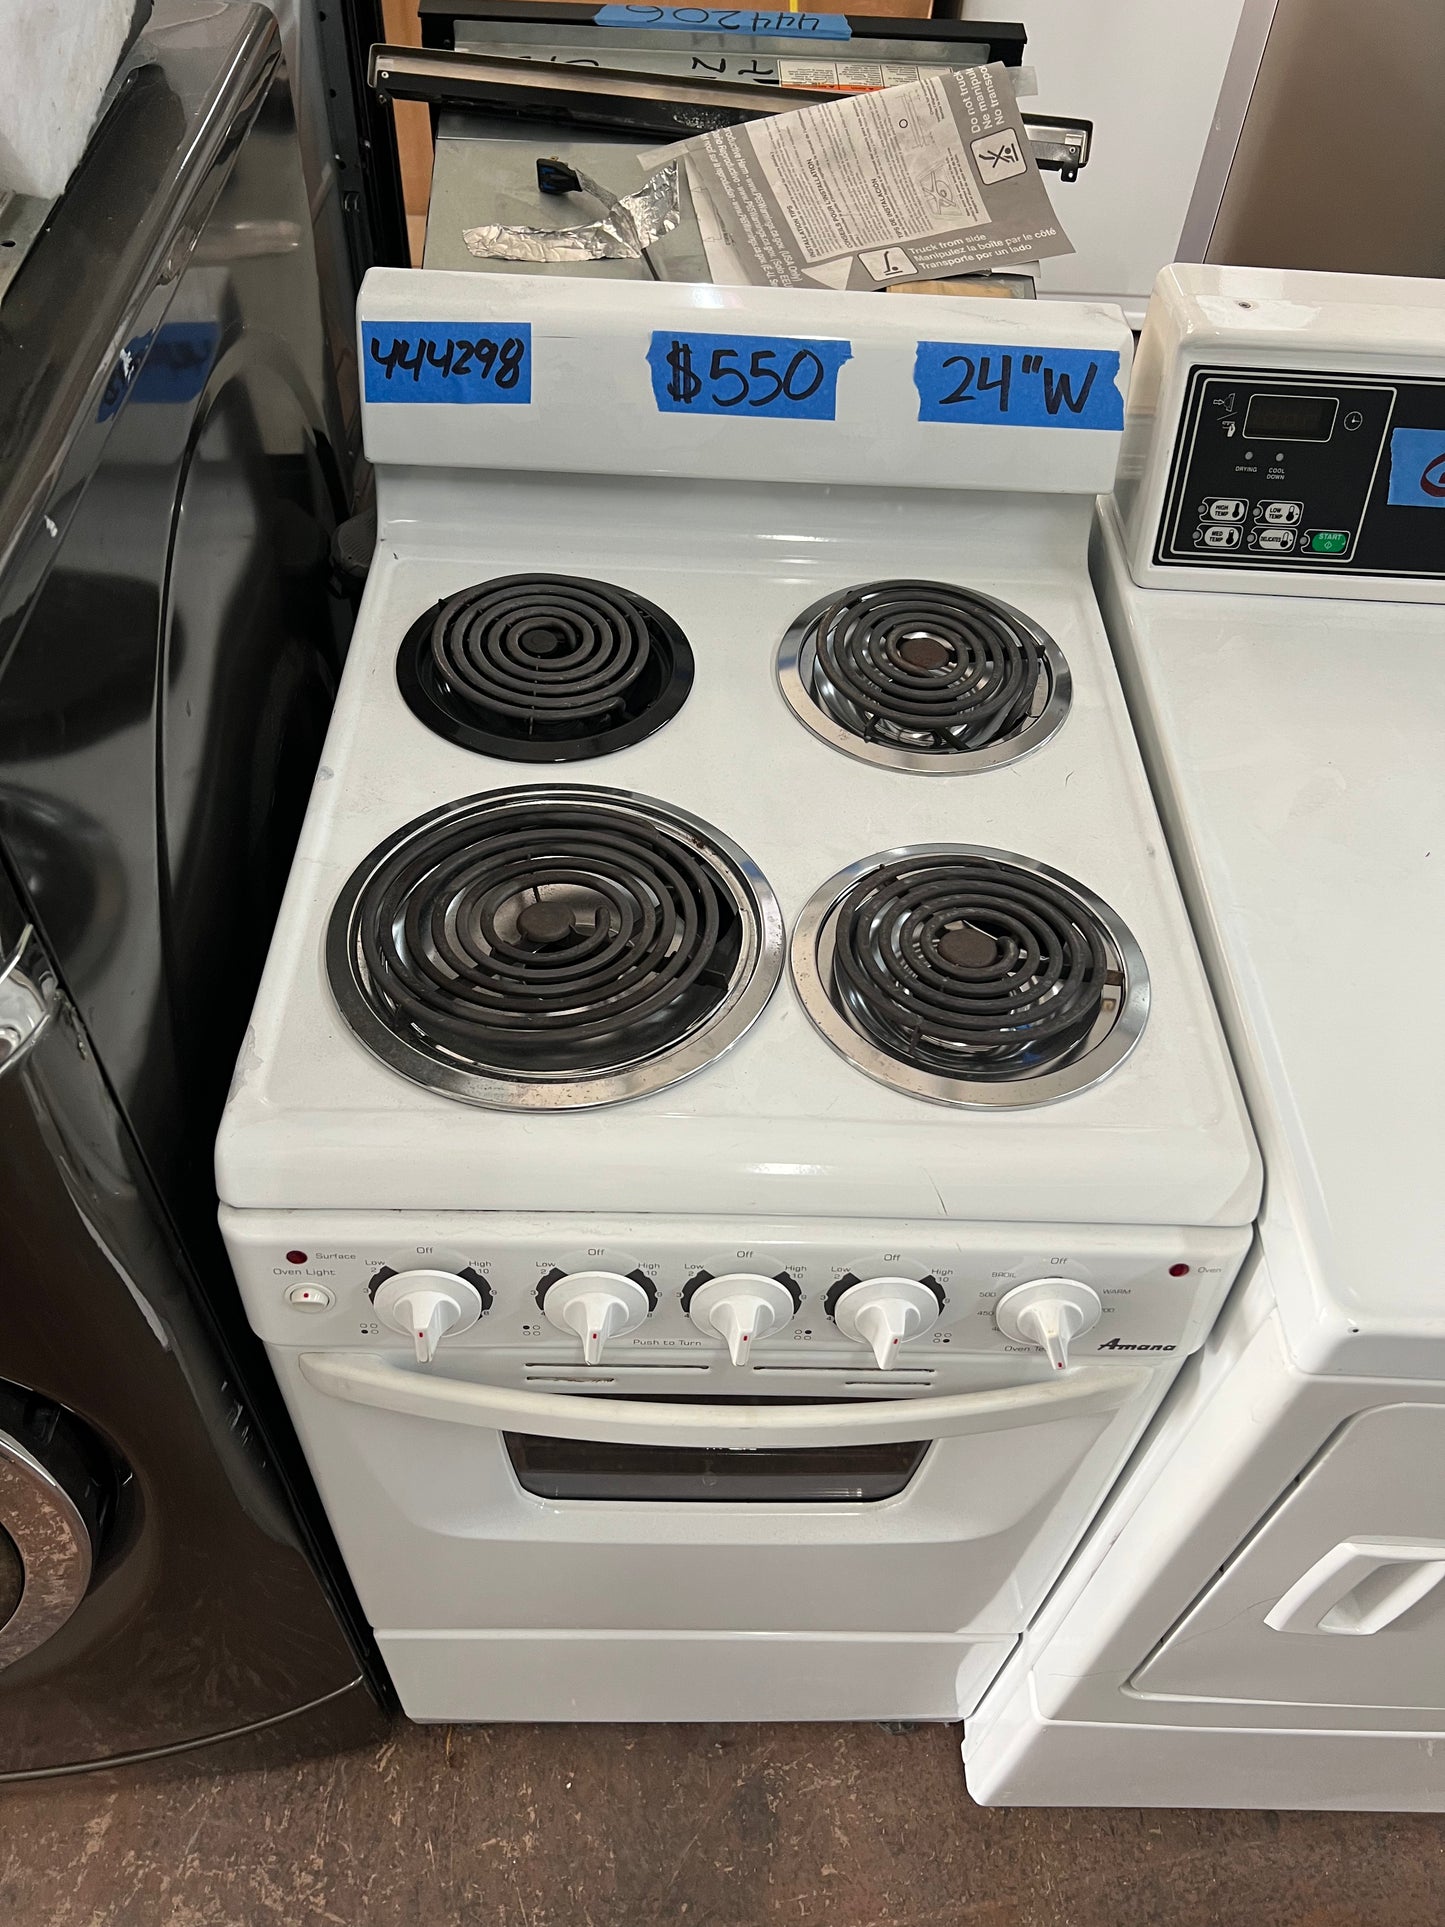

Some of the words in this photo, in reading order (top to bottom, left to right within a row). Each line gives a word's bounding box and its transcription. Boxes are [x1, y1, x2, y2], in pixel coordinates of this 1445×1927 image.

[962, 97, 975, 115] not
[983, 113, 993, 130] Ne
[995, 110, 1004, 126] No
[971, 117, 981, 134] Do
[909, 243, 938, 254] Truck
[939, 238, 964, 249] from
[965, 233, 987, 244] side
[914, 246, 966, 263] Manipulez
[967, 243, 977, 252] la
[1005, 236, 1022, 247] par
[1023, 233, 1033, 242] le
[1034, 227, 1057, 240] côté
[919, 253, 975, 270] Transporte
[976, 250, 993, 261] por
[994, 247, 1009, 257] un
[1009, 243, 1032, 254] lado
[371, 337, 525, 389] 444298
[666, 340, 825, 406] $550
[1235, 465, 1258, 473] DRYING
[1318, 533, 1343, 541] START
[315, 1252, 357, 1260] Surface
[587, 1248, 605, 1256] Off
[736, 1250, 754, 1258] Off
[883, 1253, 901, 1262] Off
[1050, 1256, 1068, 1265] Off
[469, 1260, 492, 1268] High
[637, 1262, 660, 1270] High
[784, 1264, 807, 1273] High
[272, 1268, 303, 1276] Oven
[305, 1267, 337, 1277] Light
[931, 1268, 953, 1276] High
[1197, 1266, 1222, 1274] Oven
[1097, 1338, 1177, 1352] Amana
